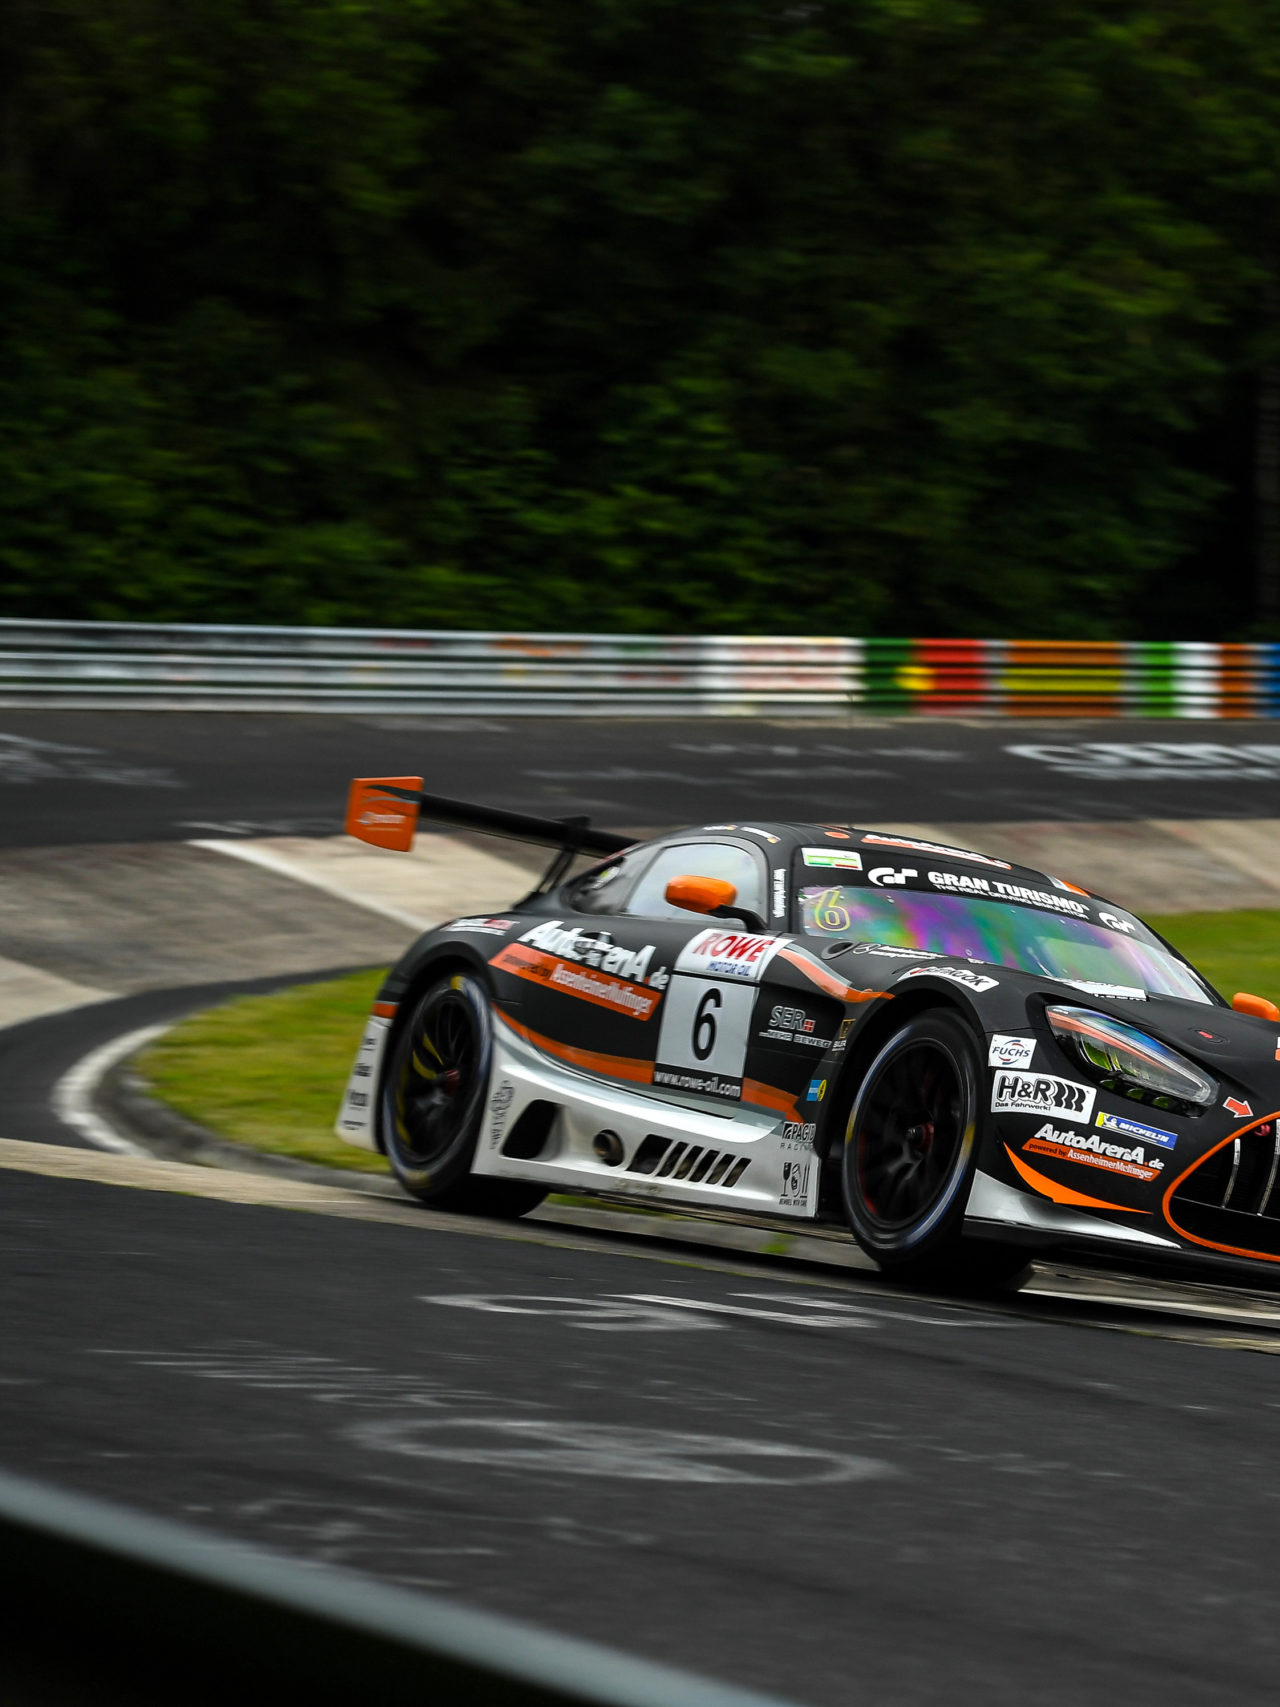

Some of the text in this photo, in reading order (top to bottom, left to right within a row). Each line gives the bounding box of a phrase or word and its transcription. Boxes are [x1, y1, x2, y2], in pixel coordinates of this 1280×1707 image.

[928, 871, 990, 891] GRAN
[933, 884, 959, 892] THE
[960, 887, 988, 897] REAL
[815, 889, 850, 932] 6
[693, 934, 777, 963] ROWE
[707, 961, 752, 976] MOTOR OIL
[692, 988, 722, 1061] 6
[991, 1047, 1030, 1058] FUCHS
[653, 1071, 741, 1097] www.rowe-oil.com
[998, 1076, 1052, 1104] H&R
[1118, 1122, 1170, 1143] MICHELIN
[1028, 1143, 1058, 1156] powered
